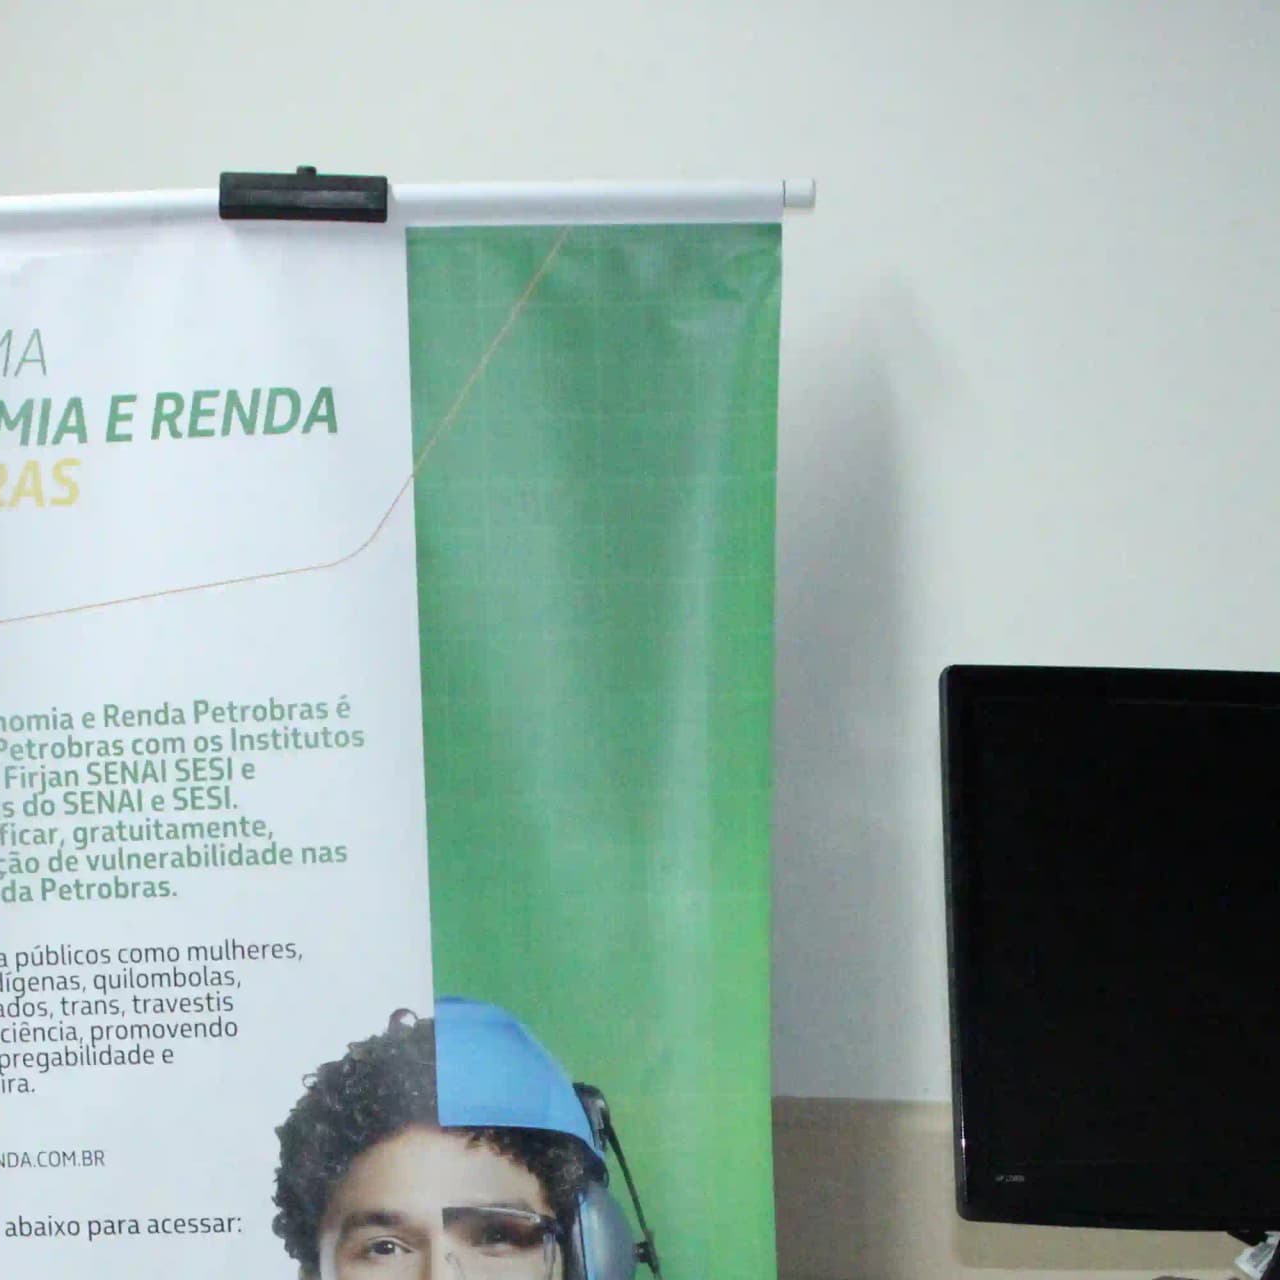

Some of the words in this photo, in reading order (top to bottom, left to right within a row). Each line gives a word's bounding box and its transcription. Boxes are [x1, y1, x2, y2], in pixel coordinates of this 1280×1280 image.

[104, 393, 138, 443] E
[149, 385, 339, 439] RENDA
[82, 712, 95, 729] e
[104, 702, 186, 728] Renda
[193, 697, 328, 724] Petrobras
[336, 695, 350, 718] é
[131, 737, 185, 756] com
[194, 735, 223, 753] os
[231, 725, 364, 752] Institutos
[4, 765, 79, 795] Firjan
[86, 759, 167, 786] SENAI
[175, 756, 233, 783] SESI
[241, 762, 255, 779] e
[23, 792, 55, 817] do
[63, 788, 143, 815] SENAI
[151, 795, 165, 812] e
[172, 785, 238, 811] SESI.
[73, 816, 273, 851] gratuitamente,
[48, 849, 79, 873] de
[86, 841, 293, 871] vulnerabilidade
[302, 845, 347, 864] nas
[1, 880, 33, 903] da
[41, 876, 177, 901] Petrobras.
[16, 945, 111, 973] públicos
[118, 948, 180, 964] como
[187, 938, 302, 962] mulheres,
[93, 965, 240, 994] quilombolas,
[60, 997, 125, 1017] trans,
[132, 991, 234, 1014] travestis
[90, 1016, 238, 1048] promovendo
[162, 1049, 174, 1064] e
[5, 1215, 80, 1238] abaixo
[88, 1219, 141, 1242] para
[147, 1217, 242, 1235] acessar:
